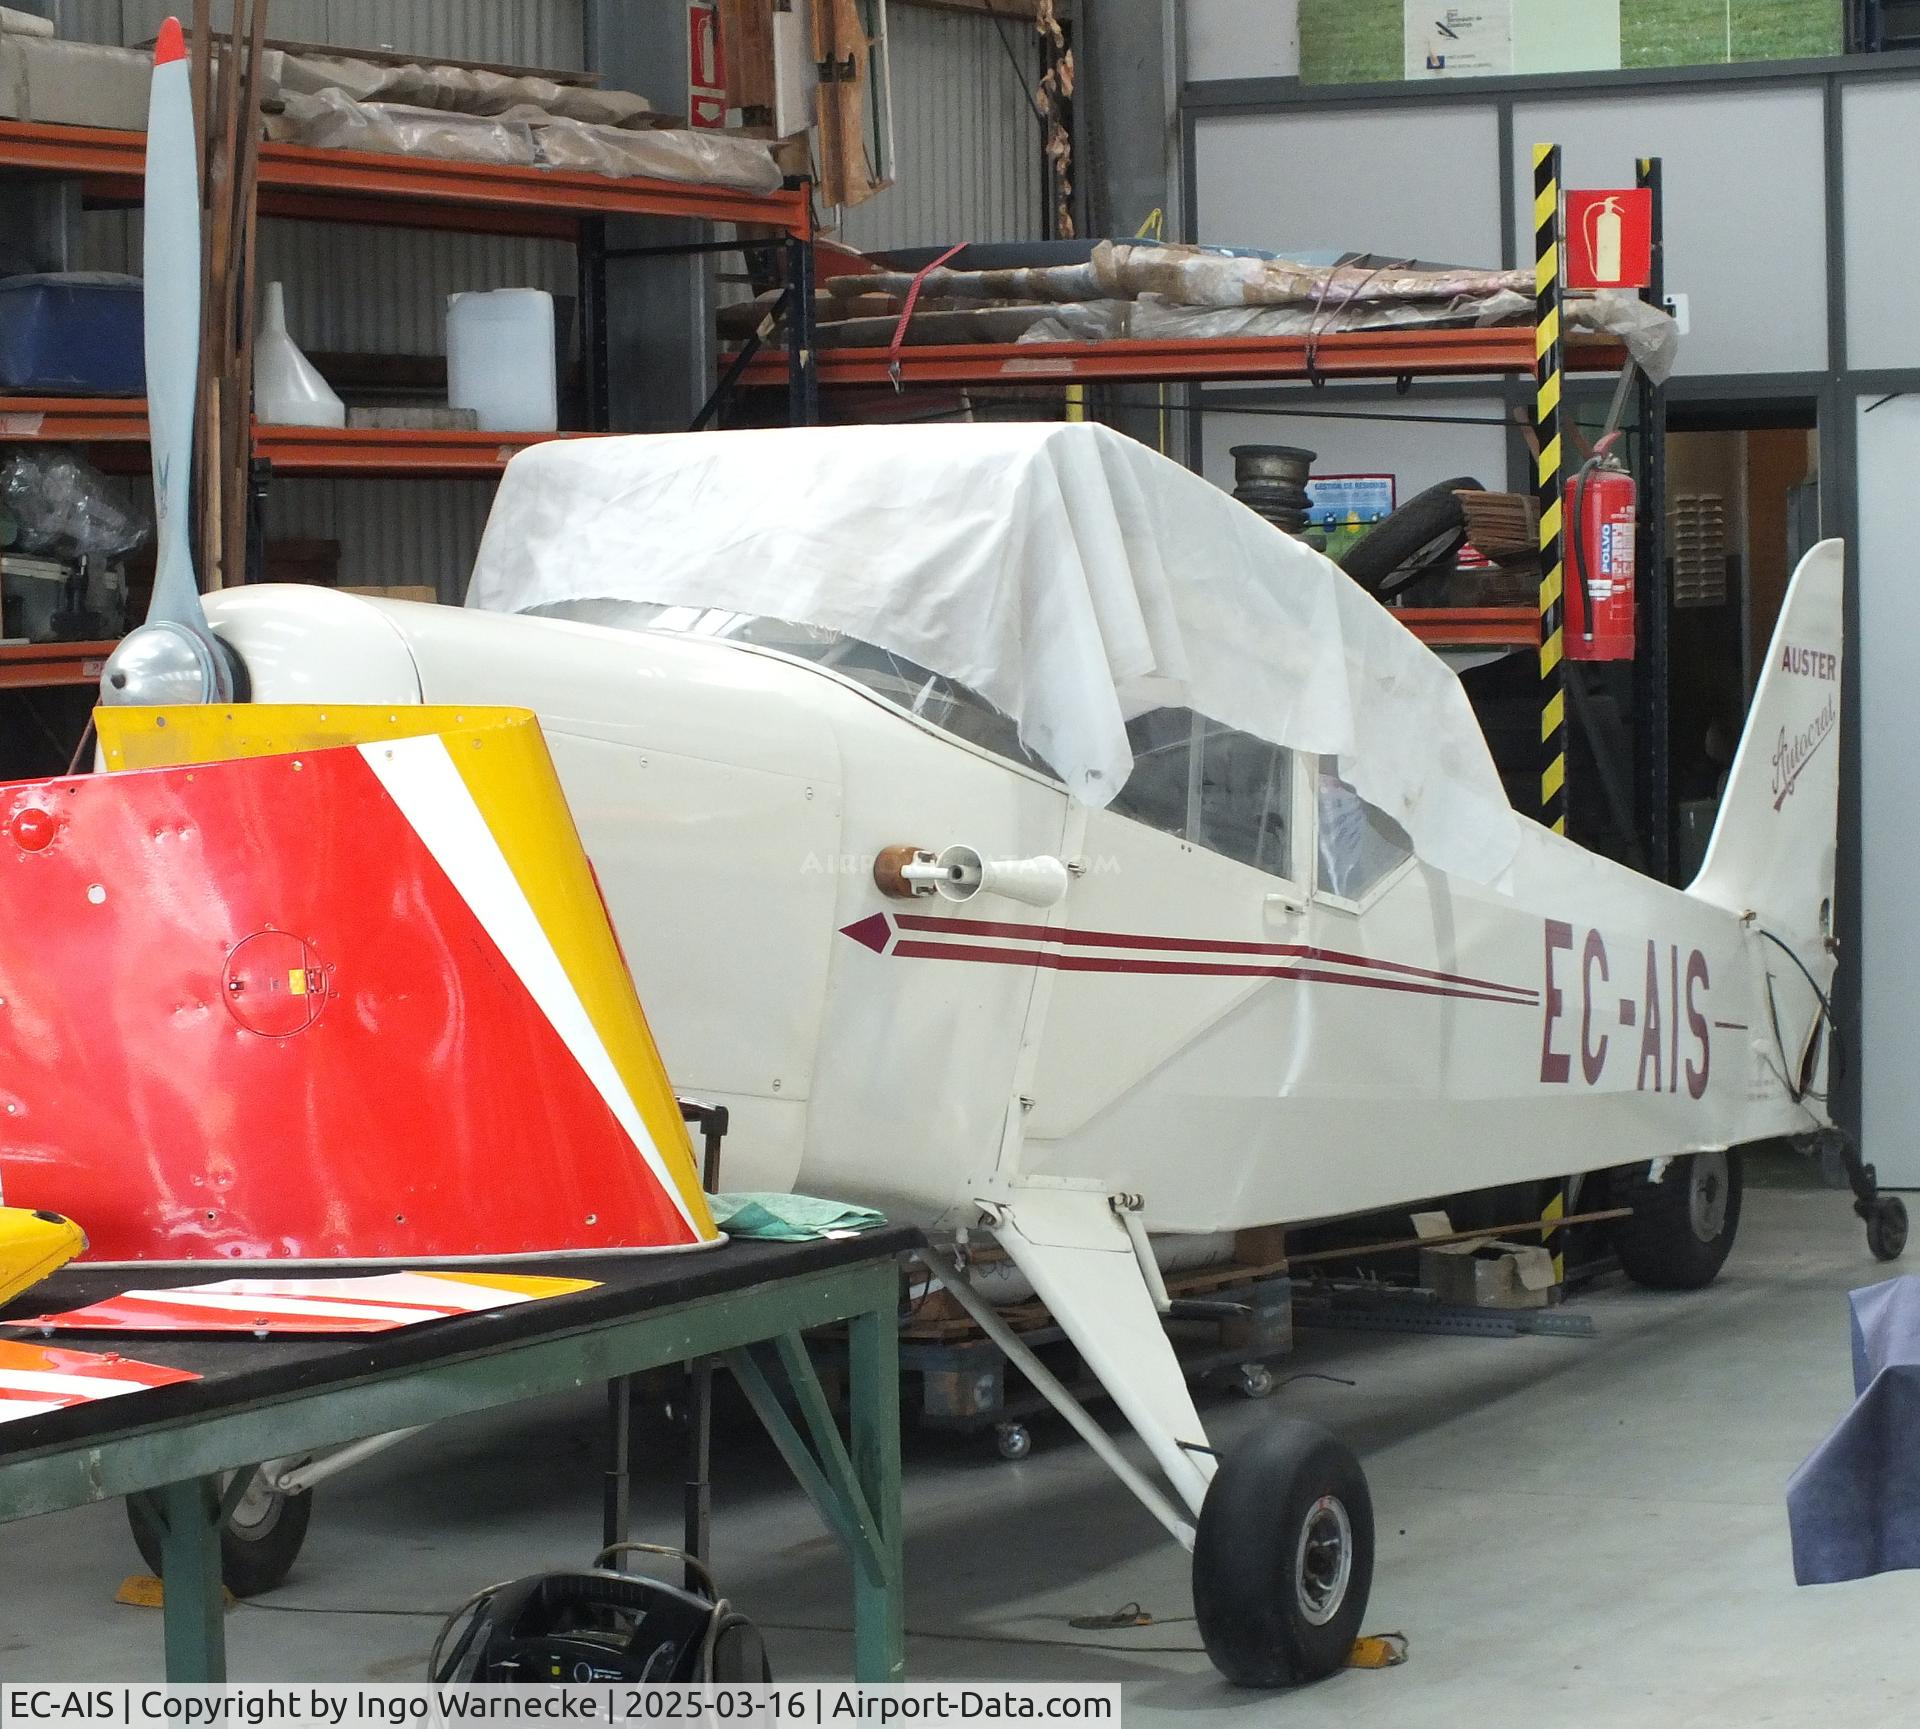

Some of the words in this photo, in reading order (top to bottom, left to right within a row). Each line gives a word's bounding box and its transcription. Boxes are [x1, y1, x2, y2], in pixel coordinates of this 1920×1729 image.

[1601, 523, 1611, 574] POLVO
[1781, 645, 1837, 682] AUSTER
[1772, 692, 1836, 799] Autocrat
[1540, 917, 1710, 1101] EC-AIS
